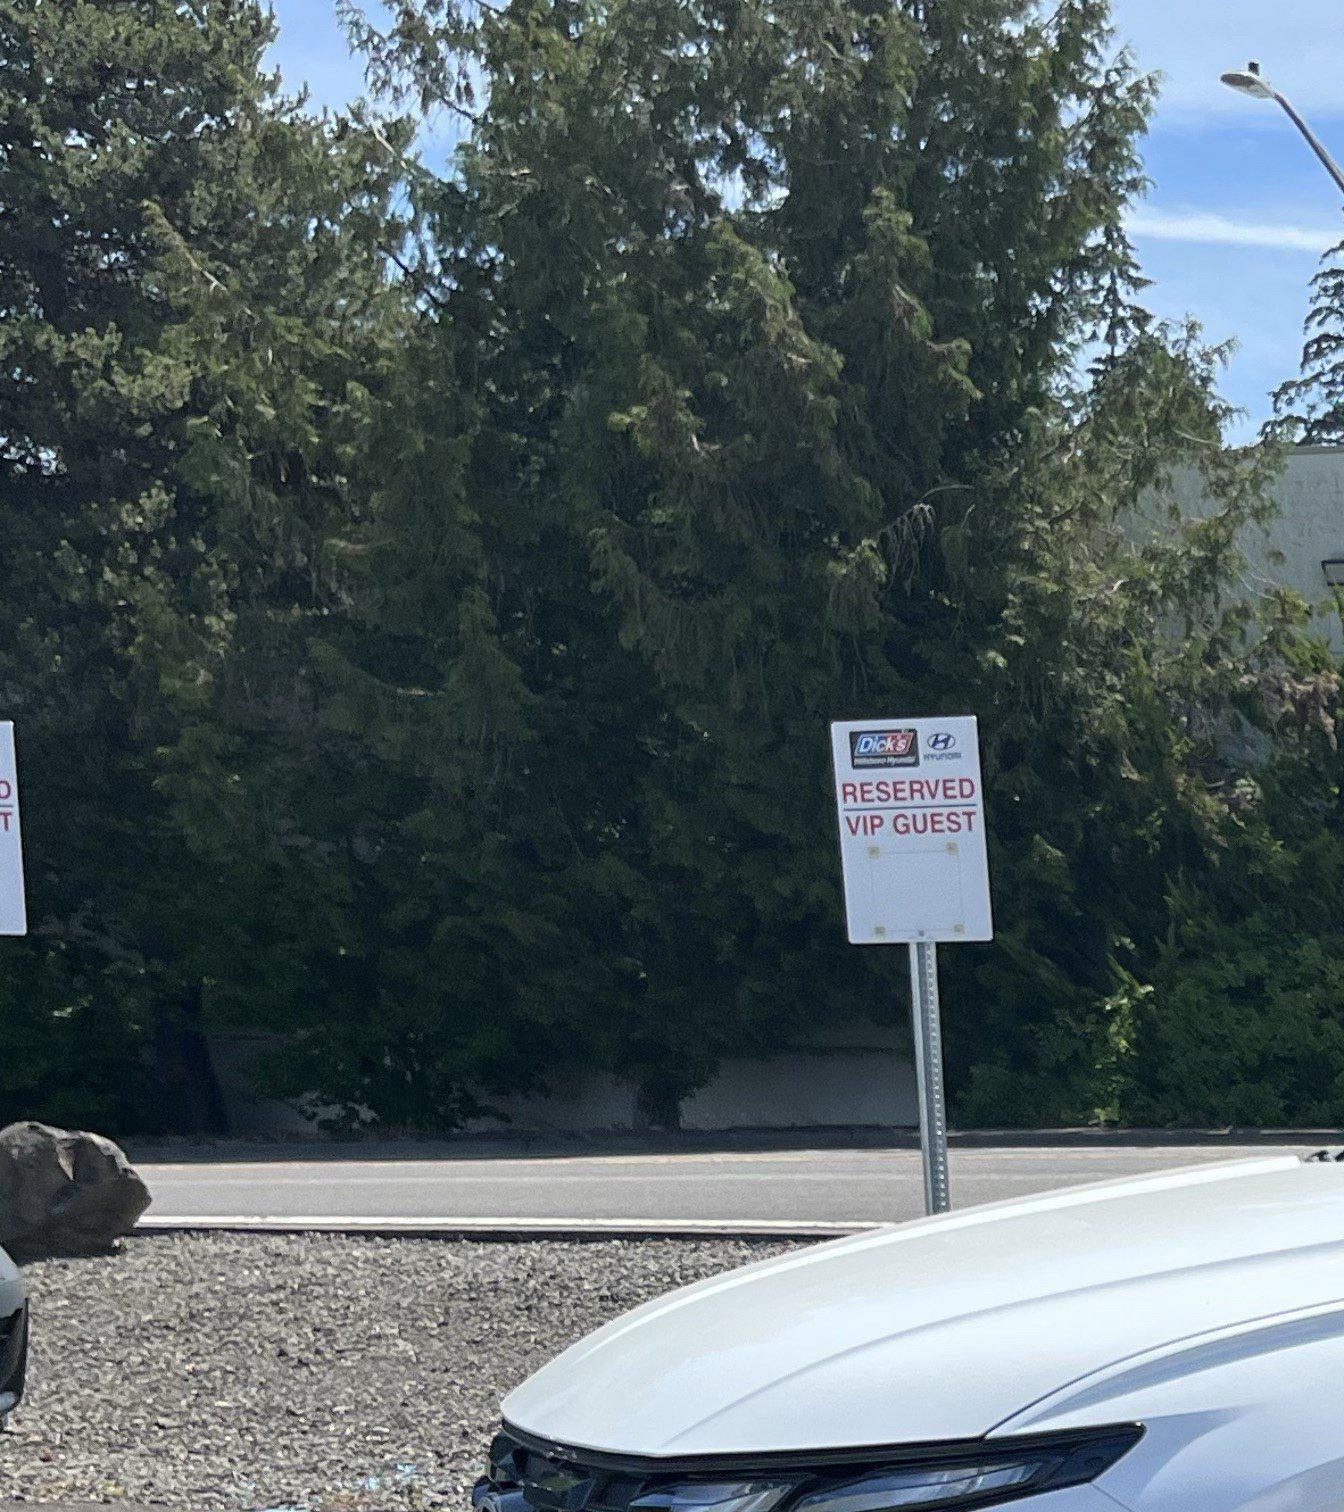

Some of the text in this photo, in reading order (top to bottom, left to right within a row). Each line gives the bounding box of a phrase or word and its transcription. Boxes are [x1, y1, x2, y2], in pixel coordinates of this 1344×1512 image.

[841, 777, 976, 805] RESERVED
[844, 810, 977, 836] VIP GUEST
